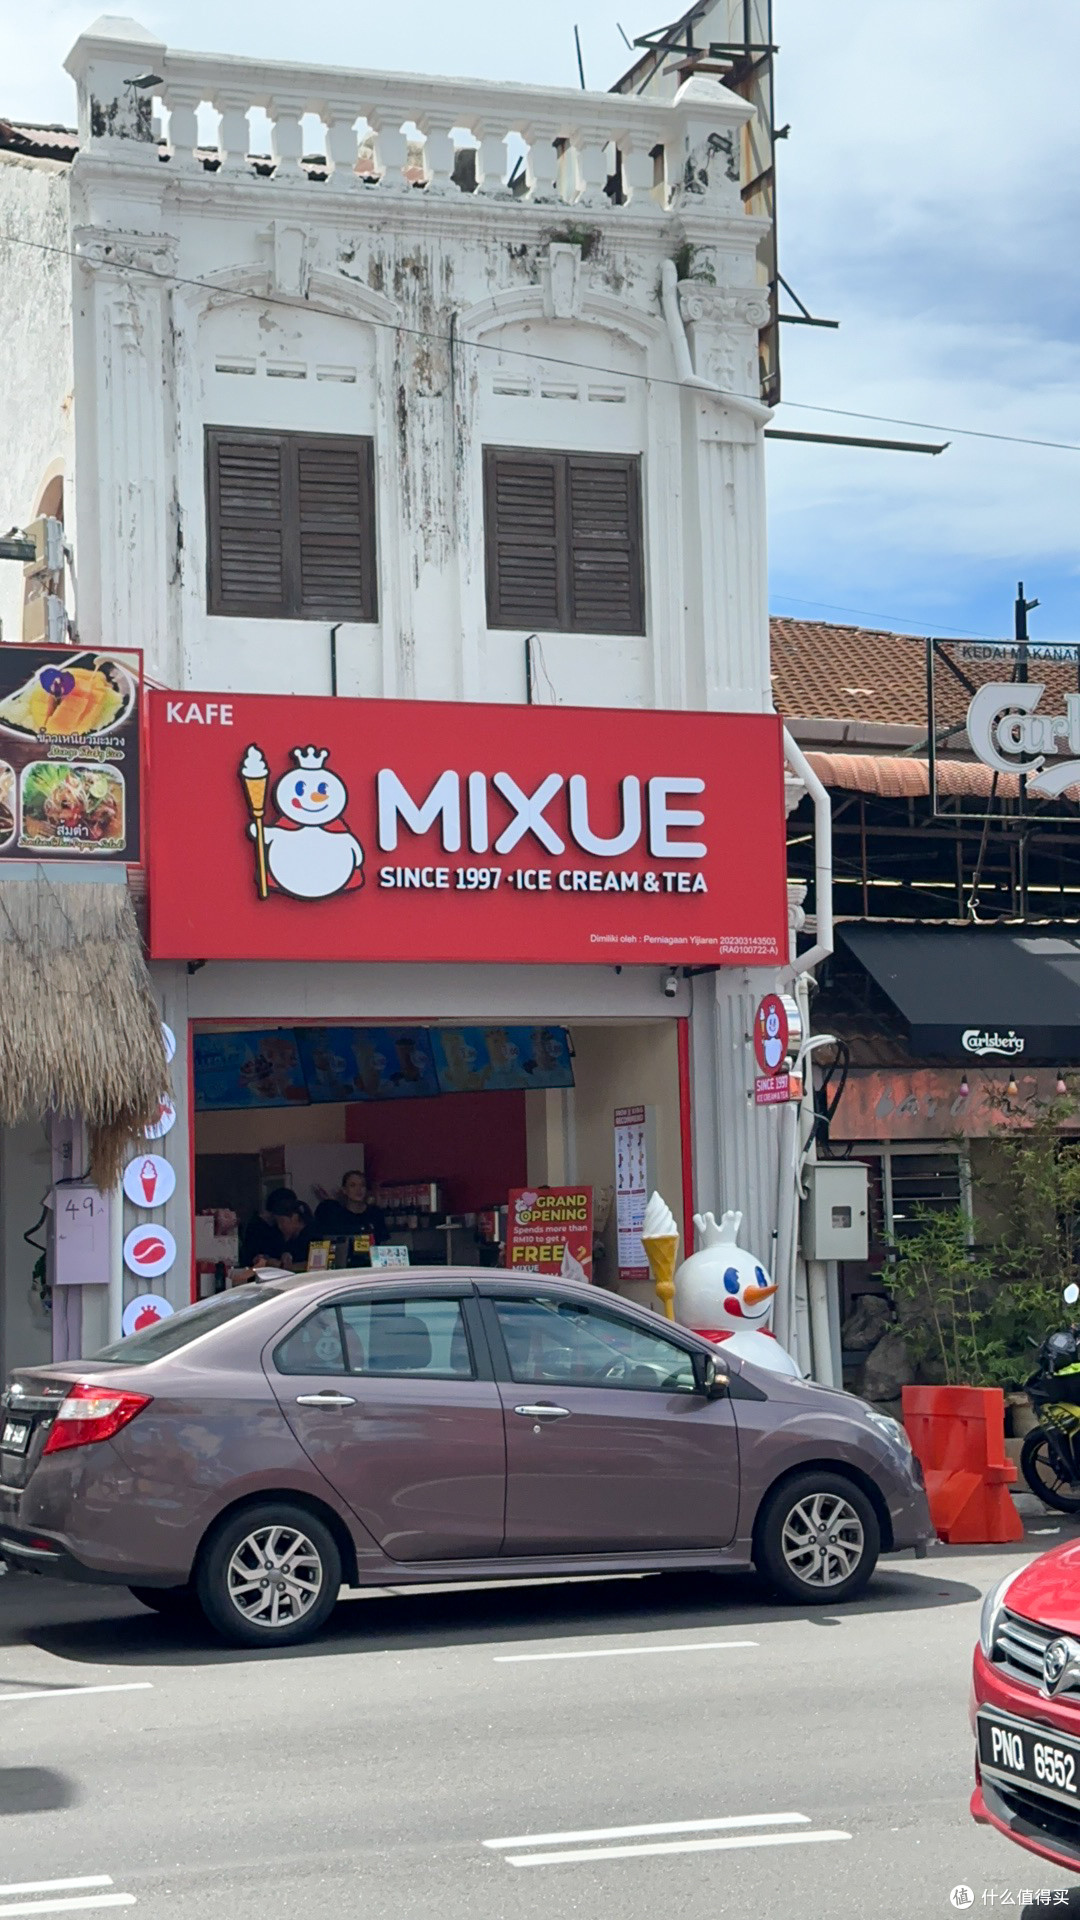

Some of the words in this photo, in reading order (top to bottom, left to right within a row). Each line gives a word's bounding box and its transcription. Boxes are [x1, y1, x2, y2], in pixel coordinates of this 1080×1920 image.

[962, 646, 1006, 660] KEDAI
[166, 702, 233, 726] KAFE
[377, 768, 708, 858] MIXUE
[380, 866, 450, 888] SINCE
[456, 867, 502, 890] 1997
[590, 934, 619, 943] Dimiliki
[620, 936, 637, 944] oleh
[720, 936, 777, 945] 202303143503
[961, 1029, 1025, 1054] Carlsberg
[756, 1077, 774, 1092] SINCE
[535, 1194, 588, 1208] GRAND
[520, 1208, 588, 1222] OPENING
[513, 1226, 544, 1235] Spends
[568, 1224, 588, 1232] than
[545, 1235, 560, 1244] get
[511, 1245, 564, 1262] FREE
[991, 1726, 1025, 1771] PNQ
[1033, 1742, 1078, 1793] 6552
